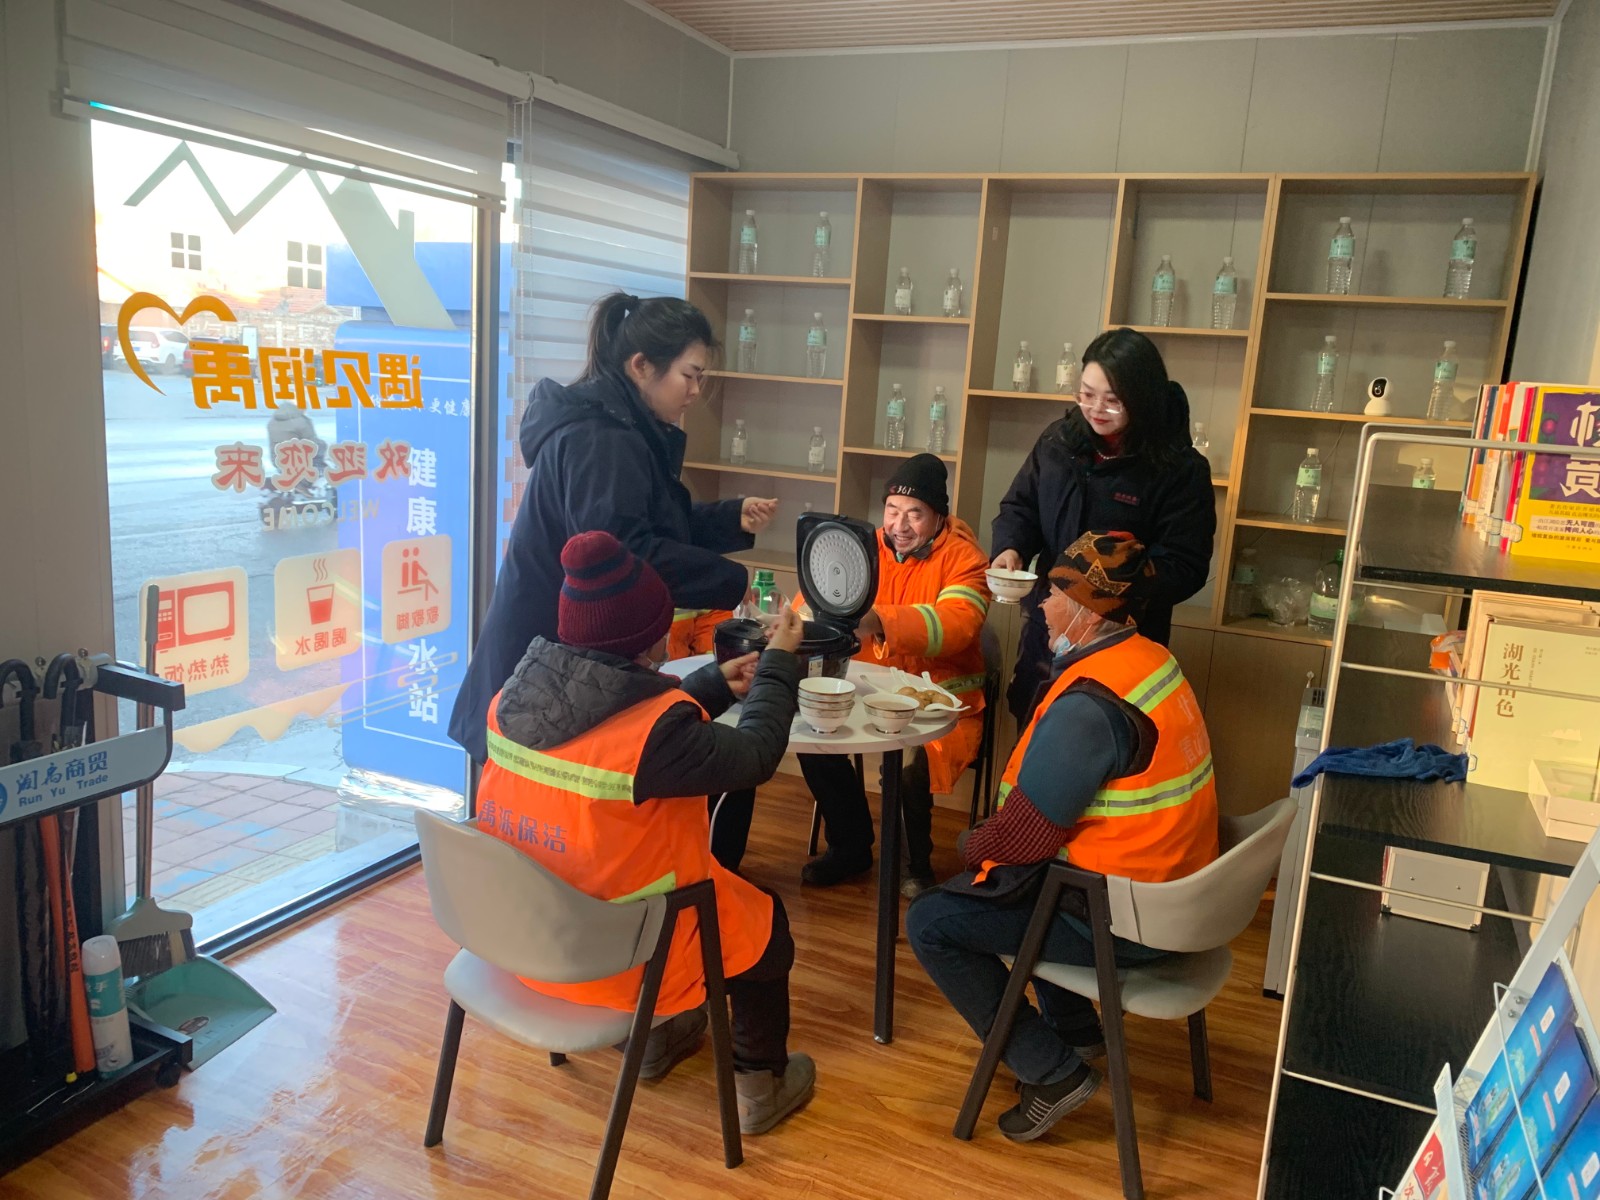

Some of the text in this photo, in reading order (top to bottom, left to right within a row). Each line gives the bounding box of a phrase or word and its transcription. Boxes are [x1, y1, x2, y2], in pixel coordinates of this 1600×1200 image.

[19, 774, 109, 807] Run Yu Trade
